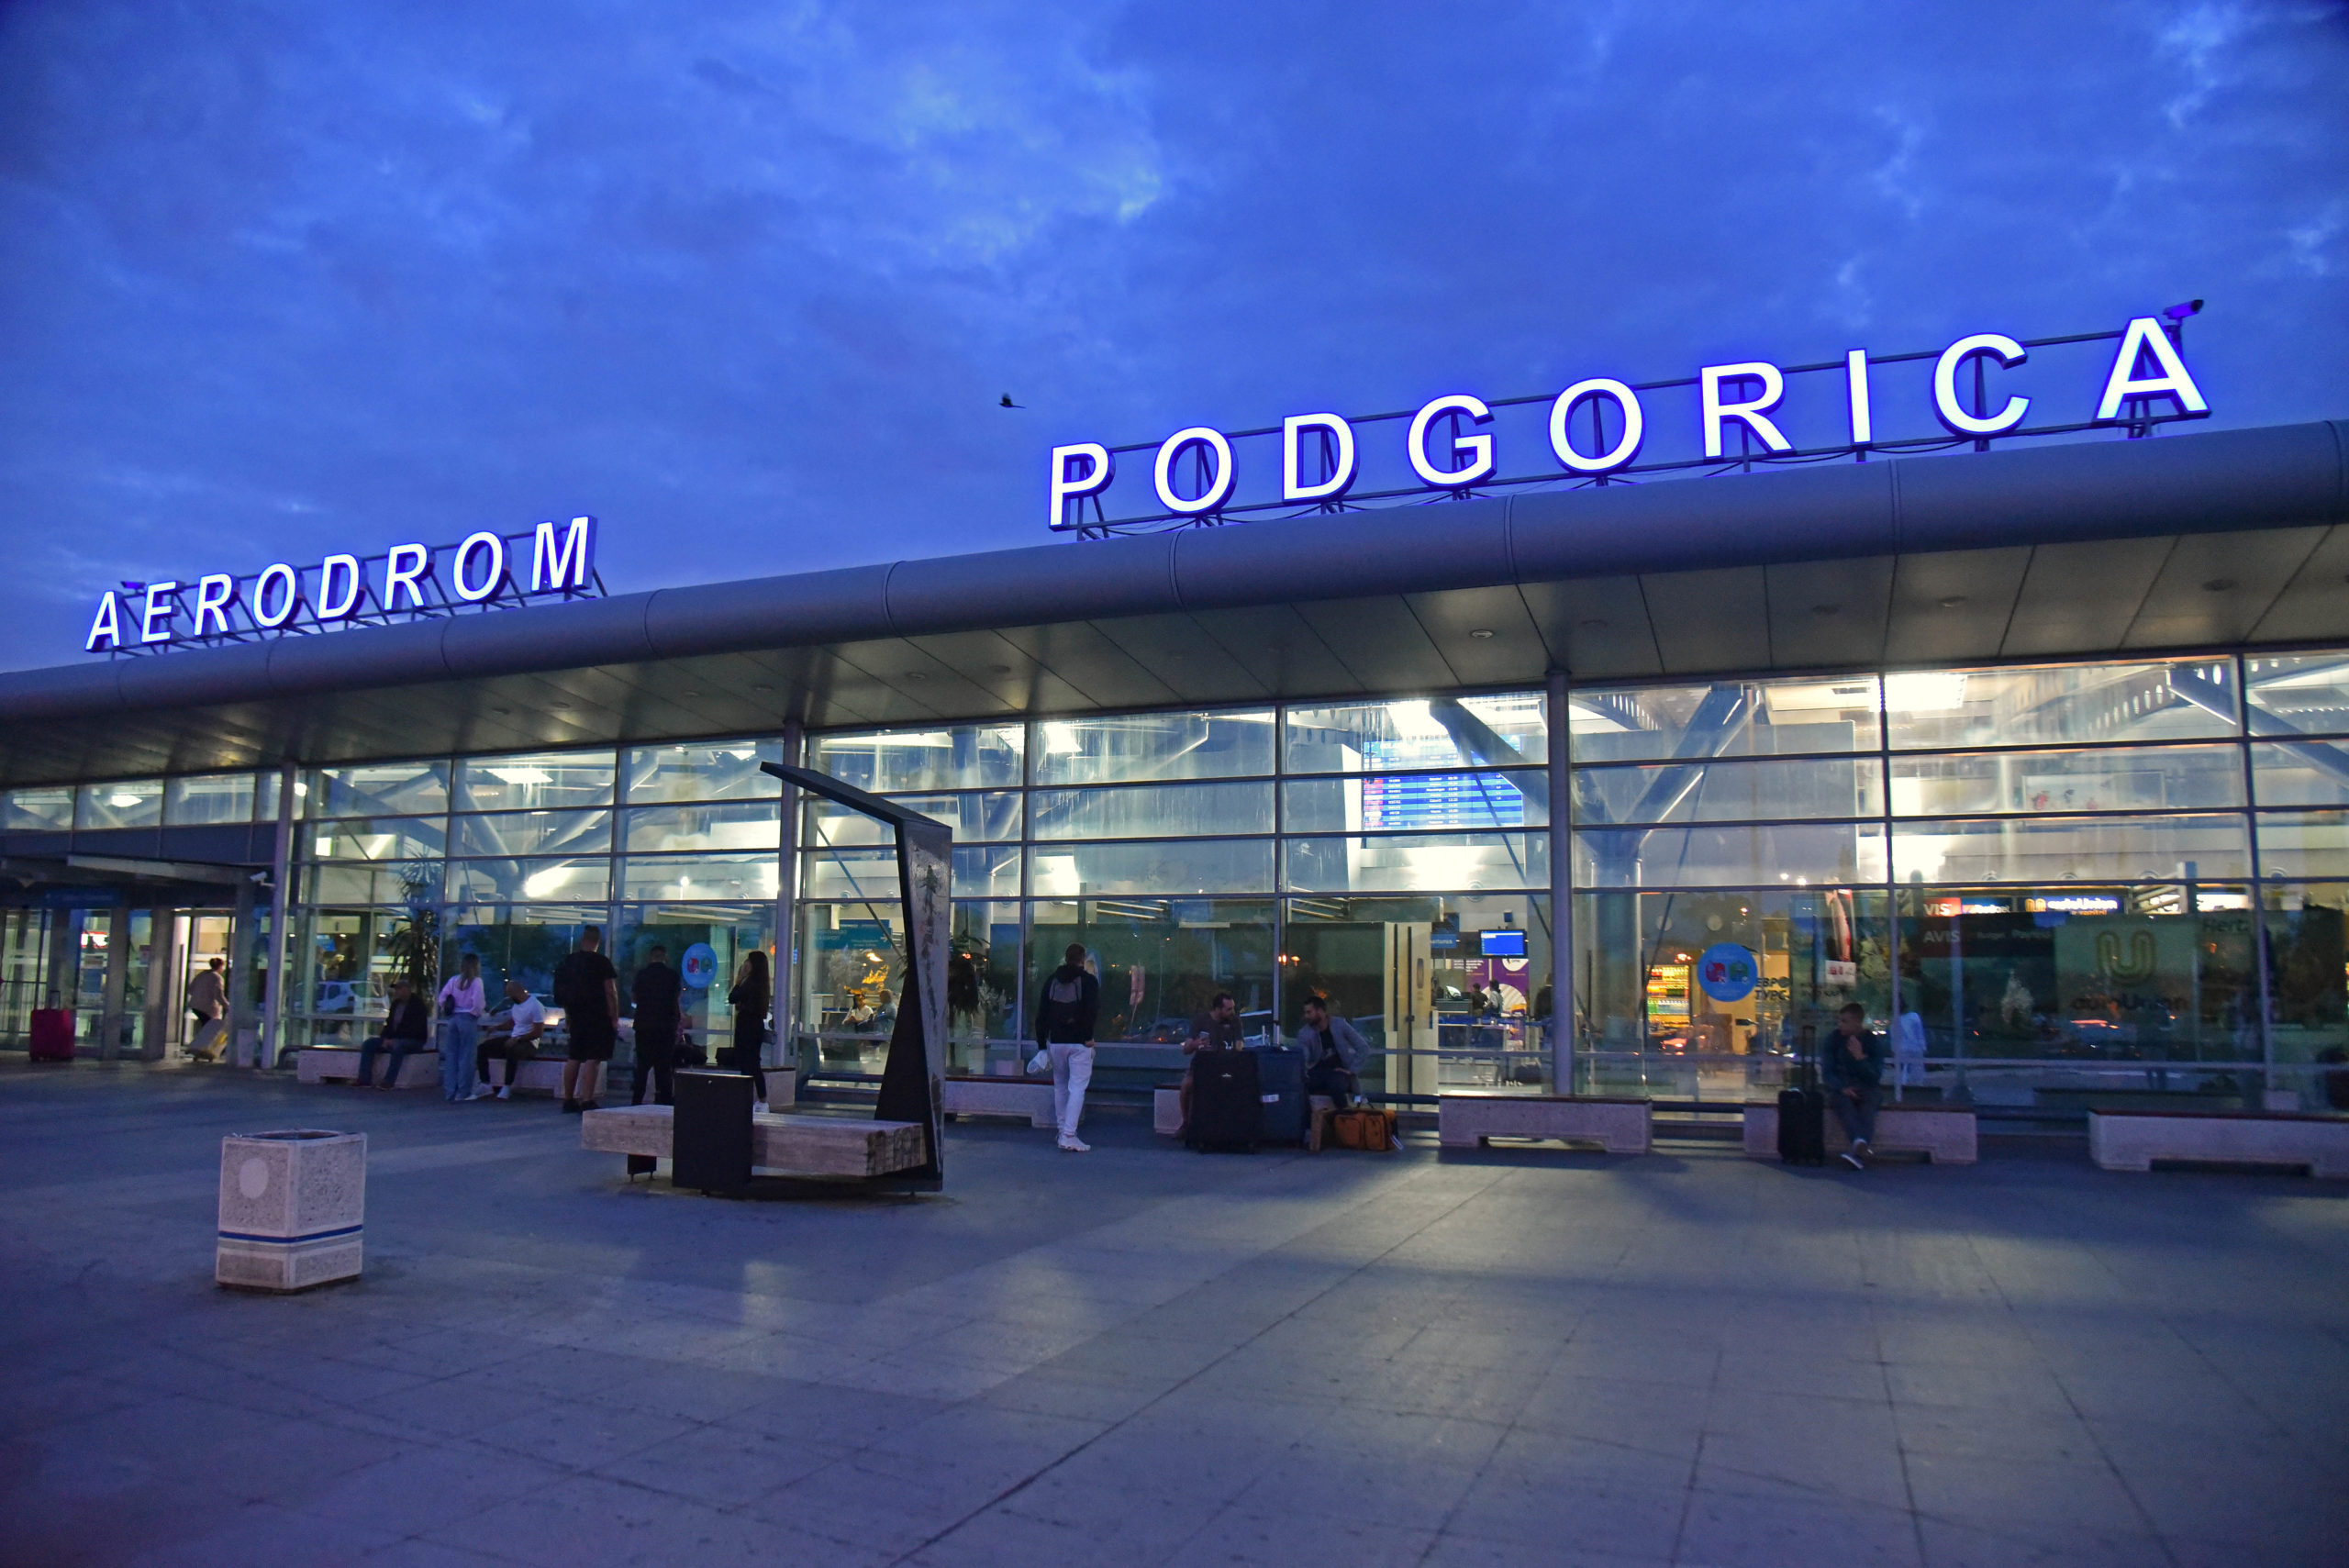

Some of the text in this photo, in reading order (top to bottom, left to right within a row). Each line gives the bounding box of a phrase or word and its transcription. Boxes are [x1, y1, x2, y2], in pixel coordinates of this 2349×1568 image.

[84, 316, 2211, 652] AERODROM PODGORICA
[1921, 903, 1951, 917] VIS
[1922, 929, 1961, 943] AVIS
